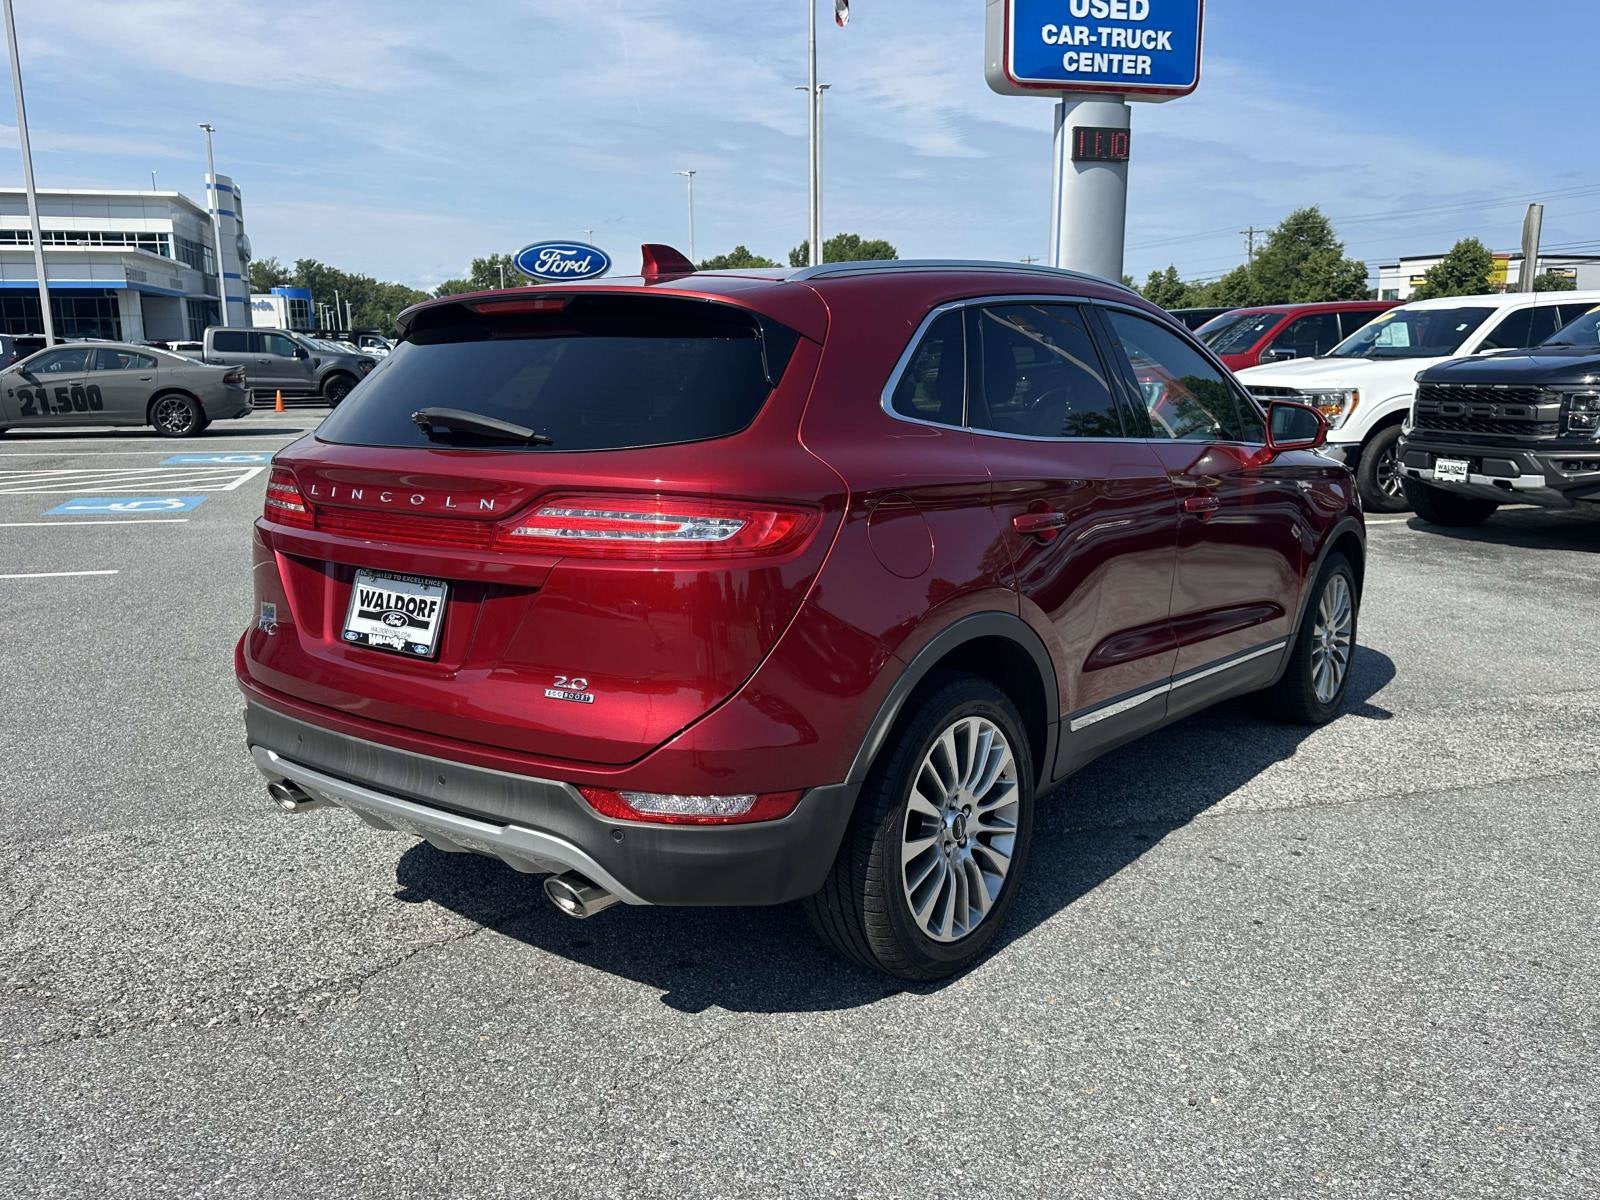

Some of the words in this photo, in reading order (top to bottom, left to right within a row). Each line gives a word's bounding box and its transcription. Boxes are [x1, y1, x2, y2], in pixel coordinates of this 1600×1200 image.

[1069, 0, 1150, 21] USED
[1041, 24, 1172, 51] CAR-TRUCK
[1063, 52, 1152, 76] CENTER
[1079, 131, 1128, 158] 11:10
[534, 248, 592, 273] Ford
[1438, 464, 1466, 472] WALDORF
[310, 484, 495, 511] LINCOLN
[402, 576, 442, 587] EXCELLENCE
[359, 589, 437, 618] WALDORF
[385, 614, 404, 627] Ford
[368, 633, 406, 650] WALDORF
[553, 675, 588, 690] 2.0
